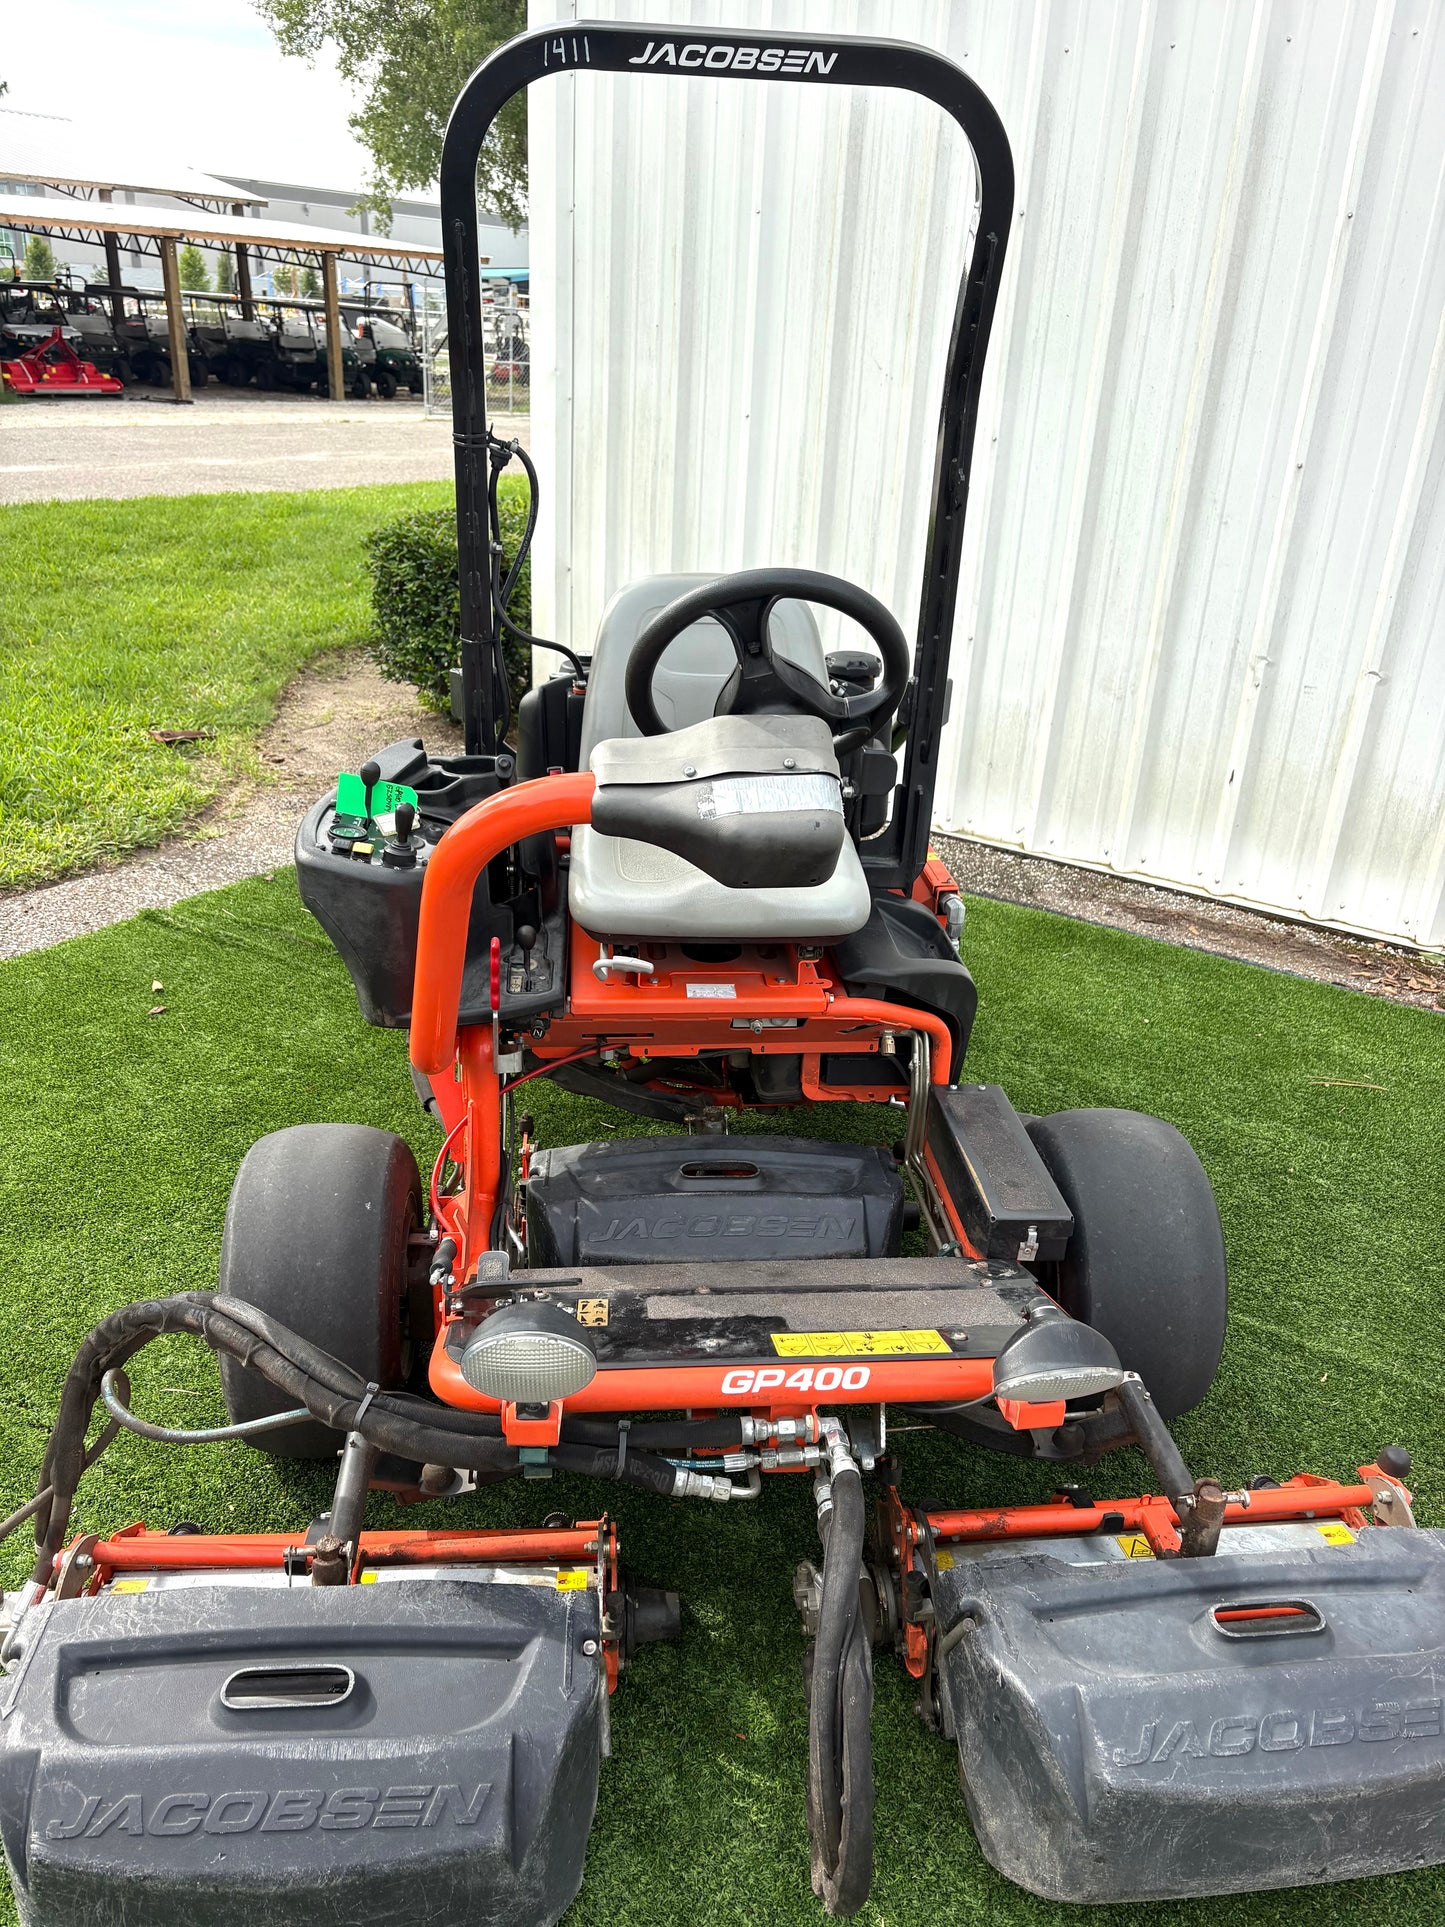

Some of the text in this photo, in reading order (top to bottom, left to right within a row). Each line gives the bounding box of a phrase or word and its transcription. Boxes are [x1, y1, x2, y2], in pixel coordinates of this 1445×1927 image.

[543, 35, 591, 67] 1411
[628, 42, 839, 75] JACOBSEN
[588, 1213, 856, 1243] JACOBSEN
[721, 1366, 871, 1395] GP400
[1112, 1697, 1445, 1767] JACOBSE
[46, 1783, 493, 1840] JACOBSEN
